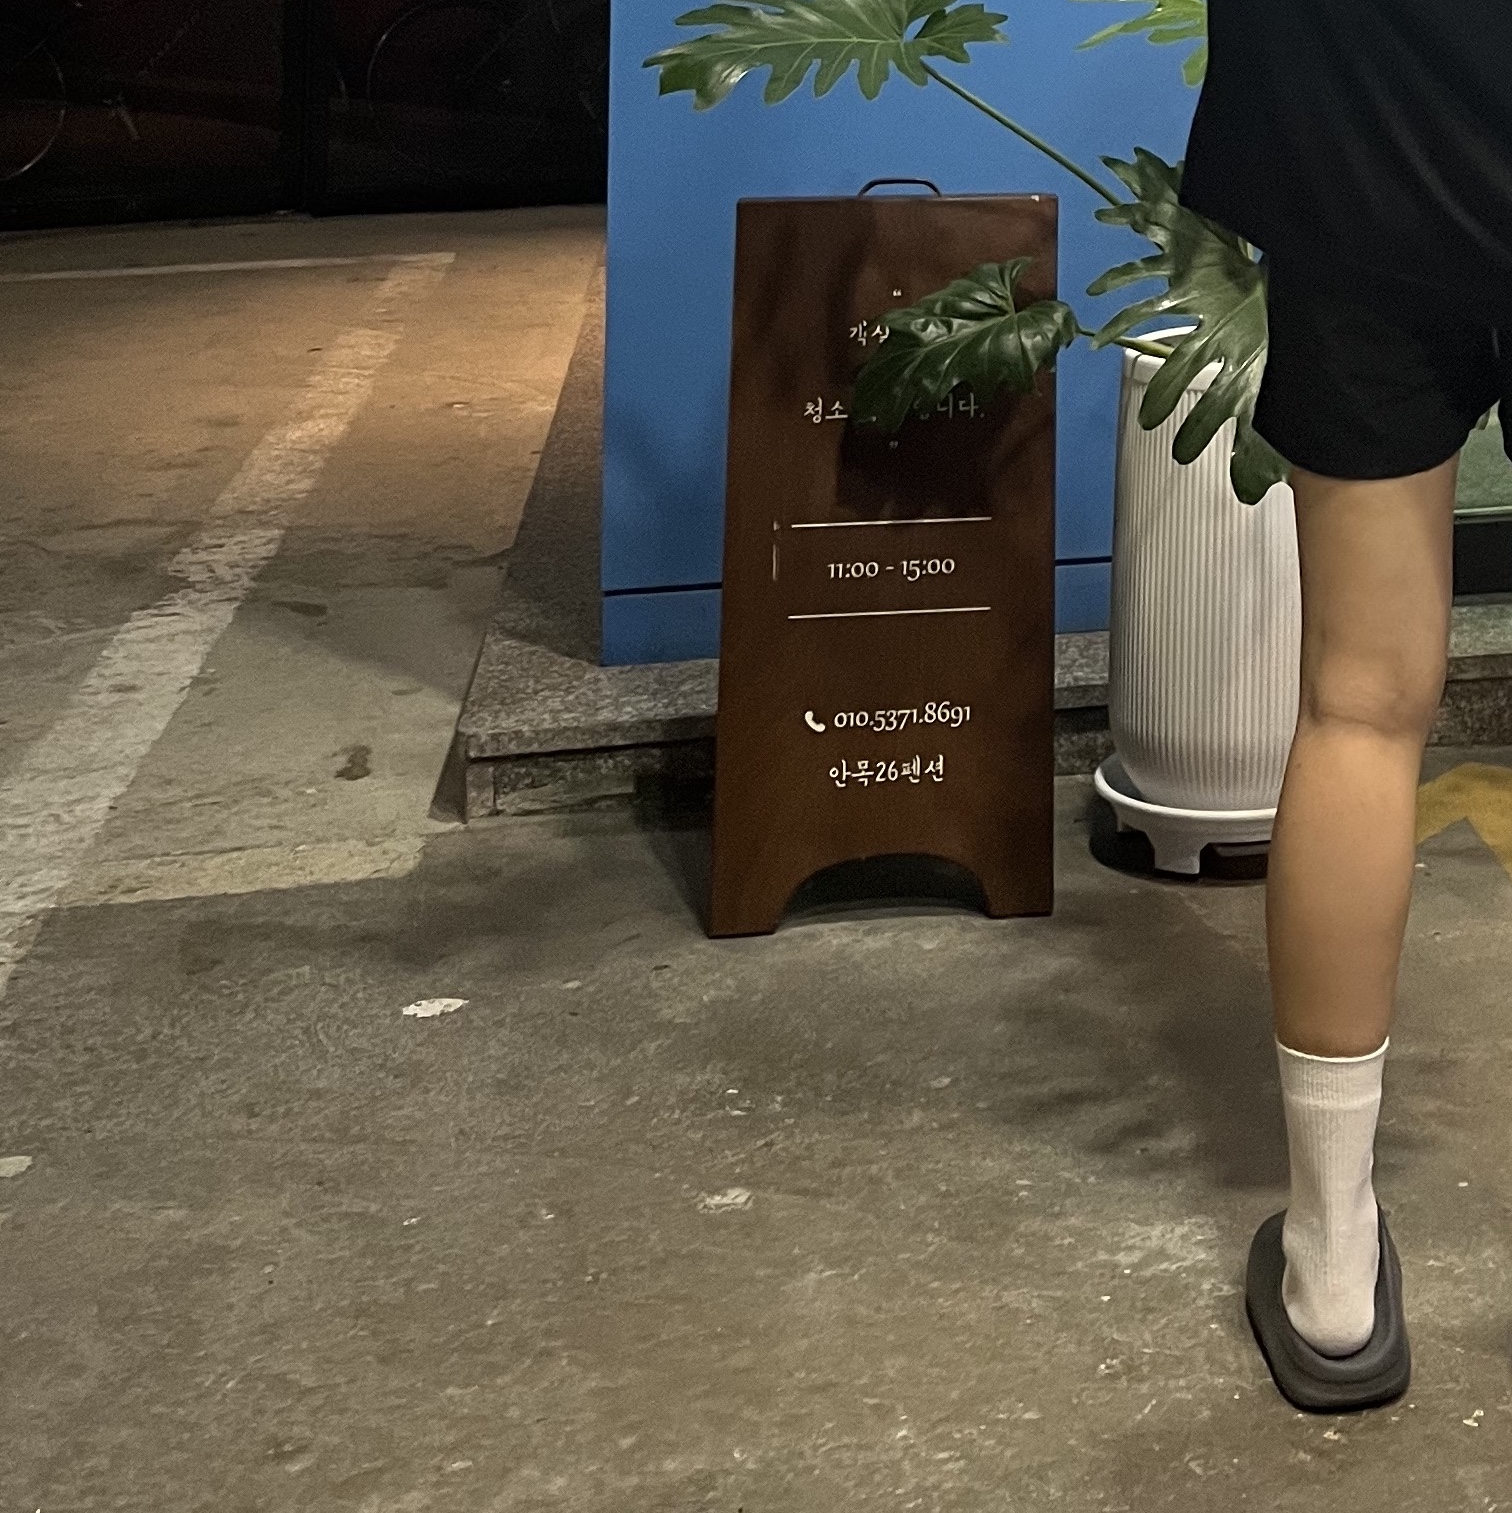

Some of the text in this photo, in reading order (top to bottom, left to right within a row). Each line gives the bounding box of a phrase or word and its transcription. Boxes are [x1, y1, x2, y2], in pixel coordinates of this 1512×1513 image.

[804, 396, 849, 424] 청소
[827, 560, 880, 579] 11:00
[901, 557, 956, 583] 15:00
[833, 700, 972, 732] 010.5371.8691
[829, 754, 945, 788] 안목26펜션
